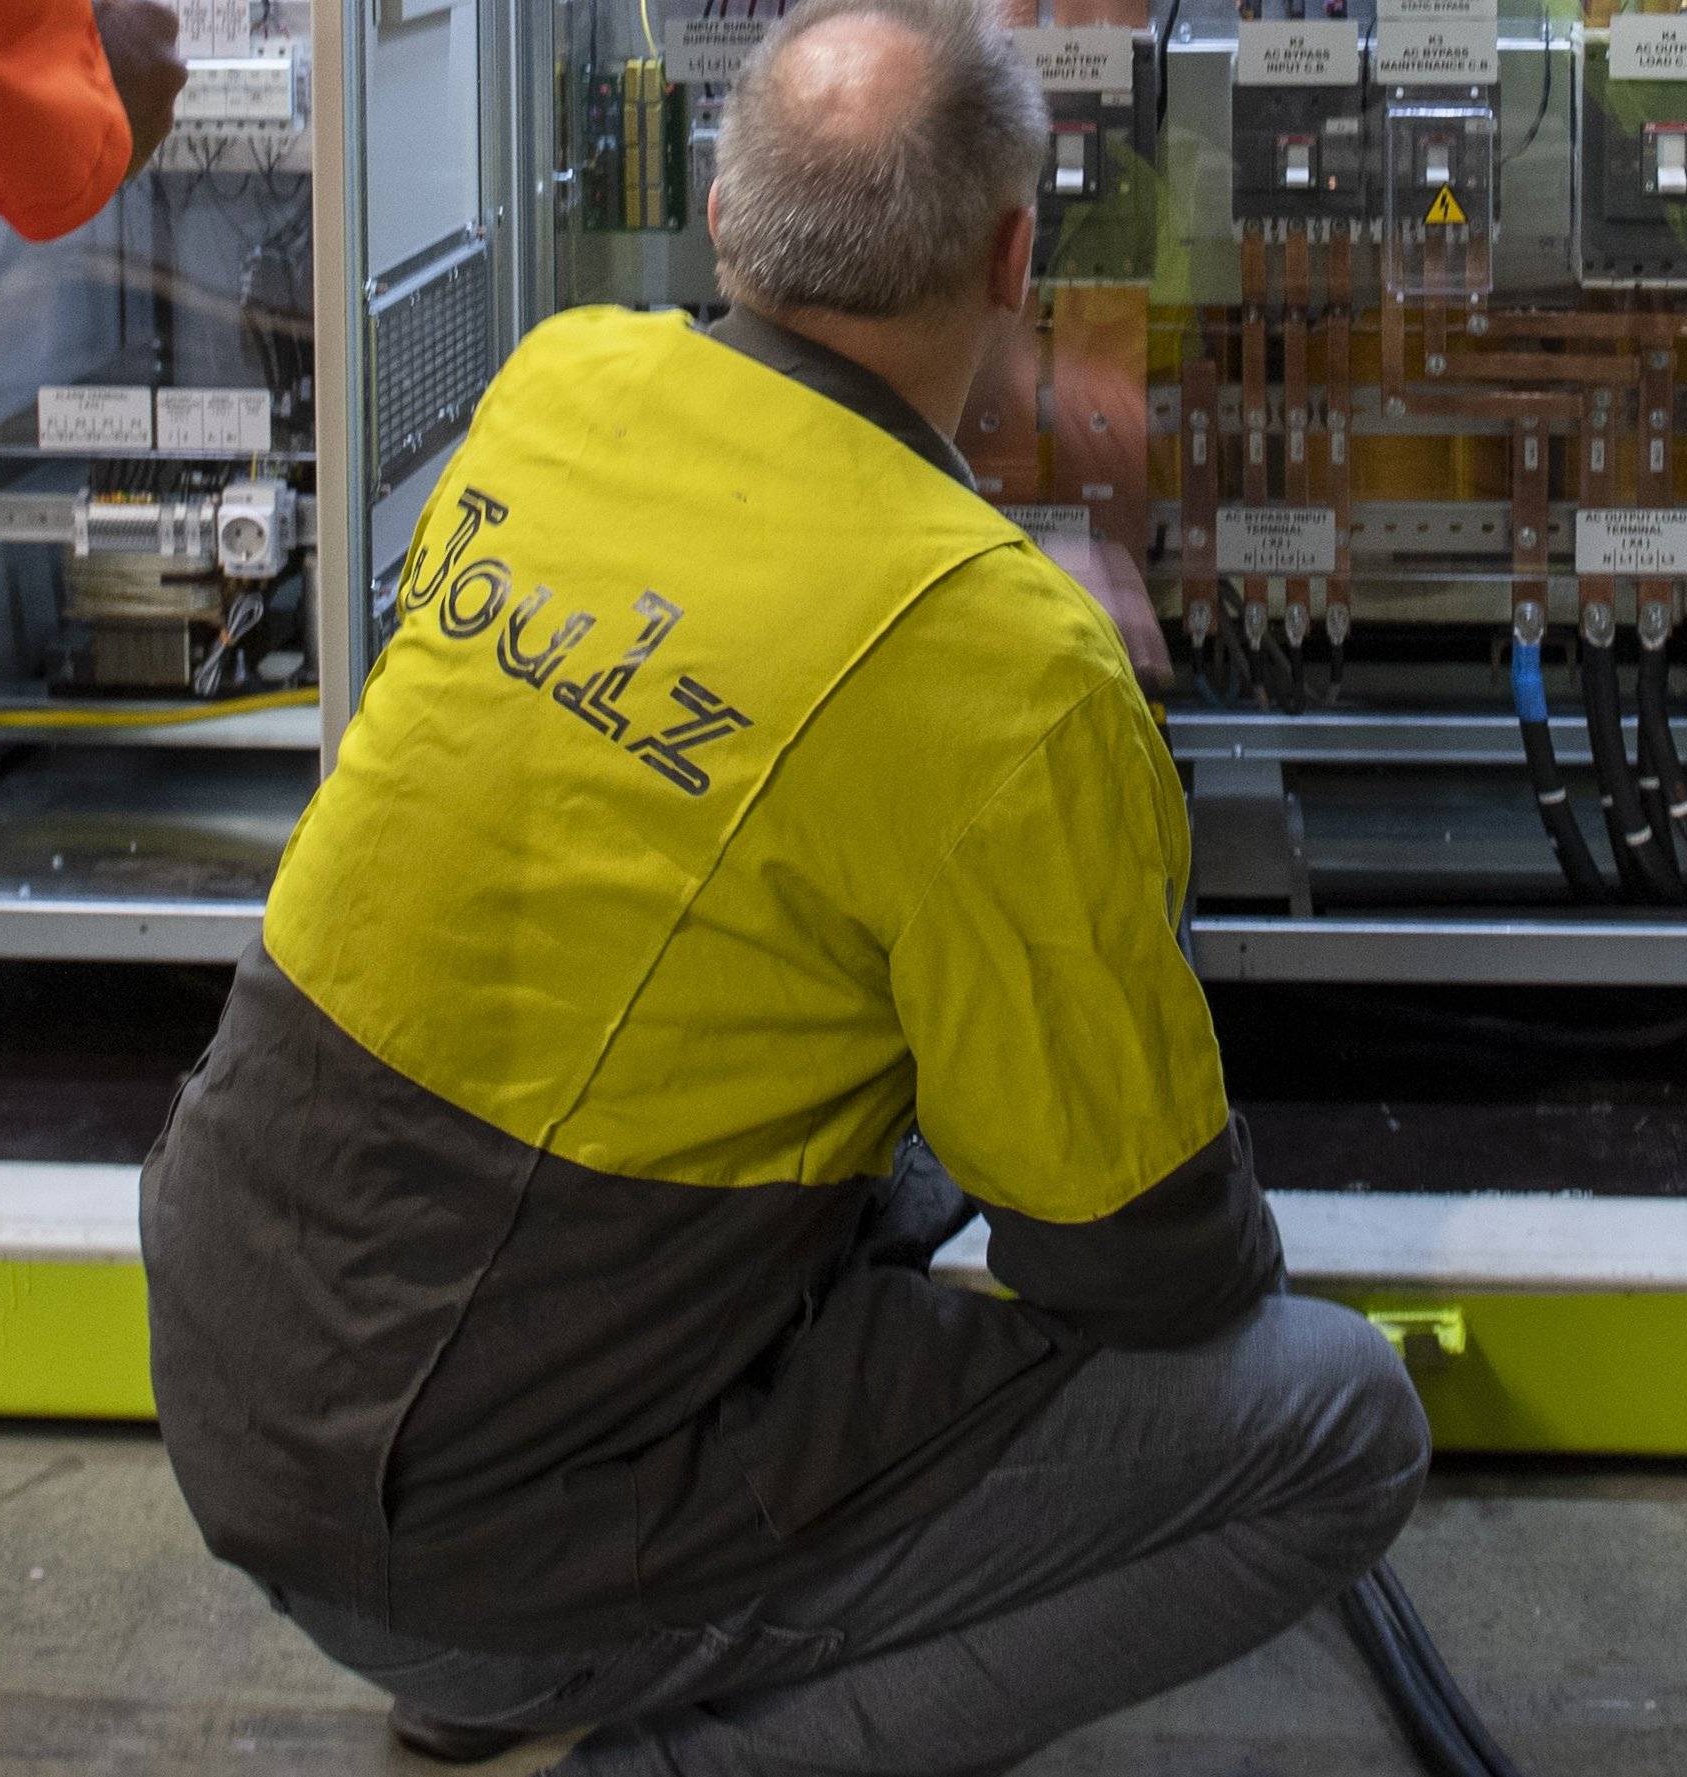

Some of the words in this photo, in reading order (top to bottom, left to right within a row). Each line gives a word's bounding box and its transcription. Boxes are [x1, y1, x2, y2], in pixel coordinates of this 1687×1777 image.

[1434, 2, 1470, 11] BYPASS
[686, 21, 719, 31] INPUT
[1264, 49, 1281, 60] AC
[1284, 49, 1331, 60] BYPASS
[1403, 47, 1419, 59] AC
[1422, 47, 1470, 59] BYPASS
[1635, 44, 1652, 55] AC
[1036, 54, 1052, 65] DC
[1055, 54, 1108, 65] BATTERY
[1639, 55, 1672, 67] LOAD
[1266, 62, 1300, 73] INPUT
[1380, 60, 1465, 72] MAINTENANCE
[1042, 68, 1076, 79] INPUT
[1225, 512, 1241, 523] AC
[1244, 512, 1291, 523] BYPASS
[1294, 512, 1326, 523] INPUT
[1585, 512, 1601, 523] AC
[1604, 512, 1651, 523] OUTPUT
[1655, 512, 1687, 523] LOAD
[1247, 524, 1302, 535] TERMINAL
[1607, 524, 1661, 535] TERMINAL
[403, 486, 756, 796] Joulz
